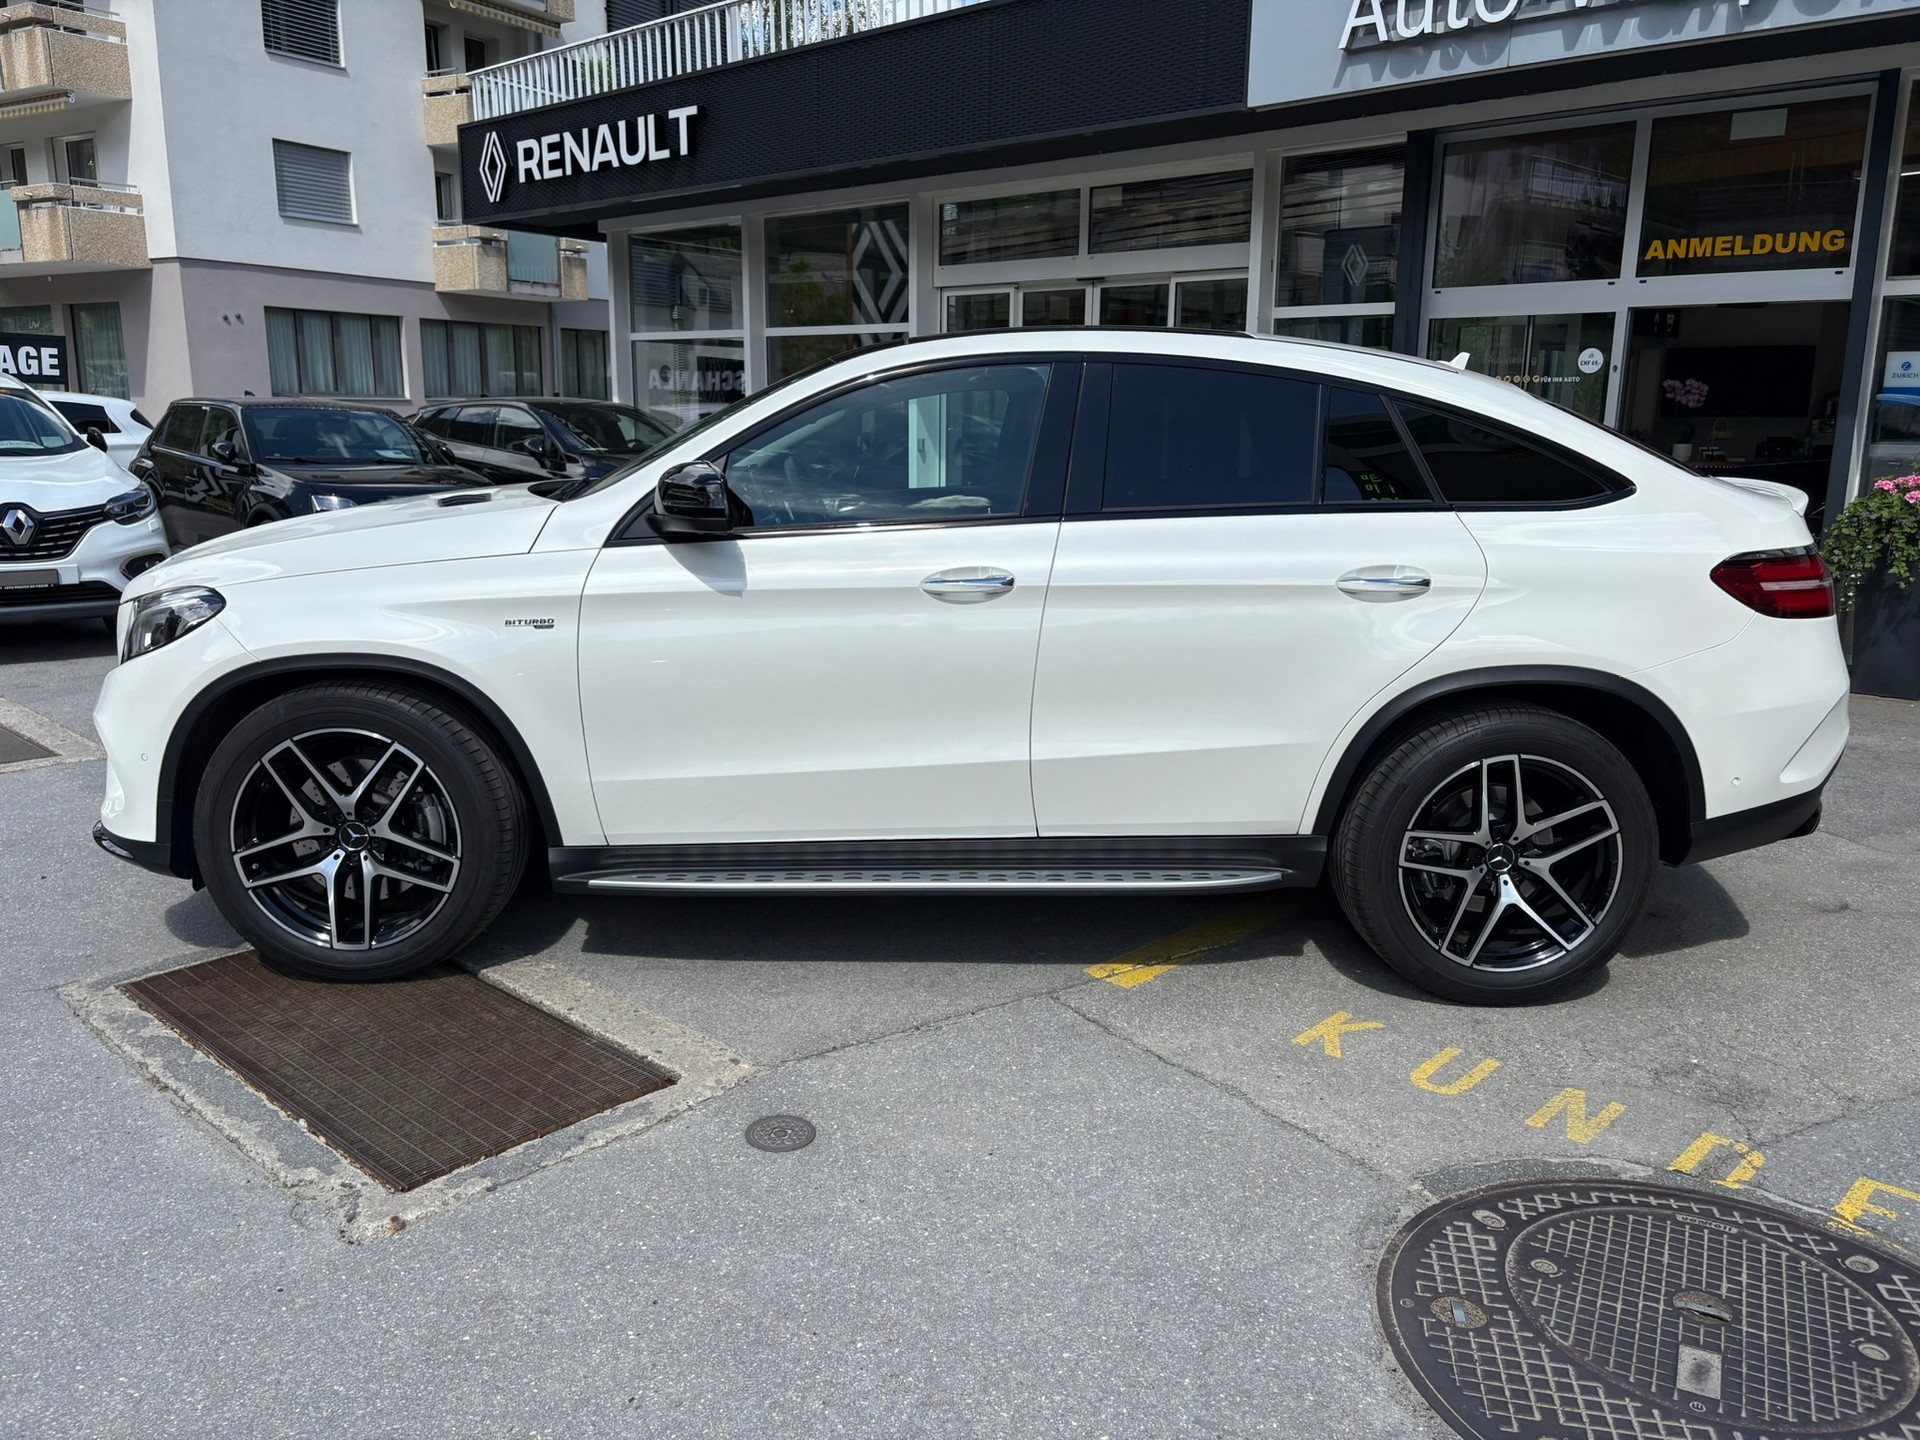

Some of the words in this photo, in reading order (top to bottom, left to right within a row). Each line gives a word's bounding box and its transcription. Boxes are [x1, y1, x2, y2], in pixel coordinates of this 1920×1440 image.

[516, 105, 698, 184] RENAULT
[1644, 229, 1845, 260] ANMELDUNG
[0, 344, 60, 376] AGE
[1291, 1011, 1920, 1236] KUNDE
